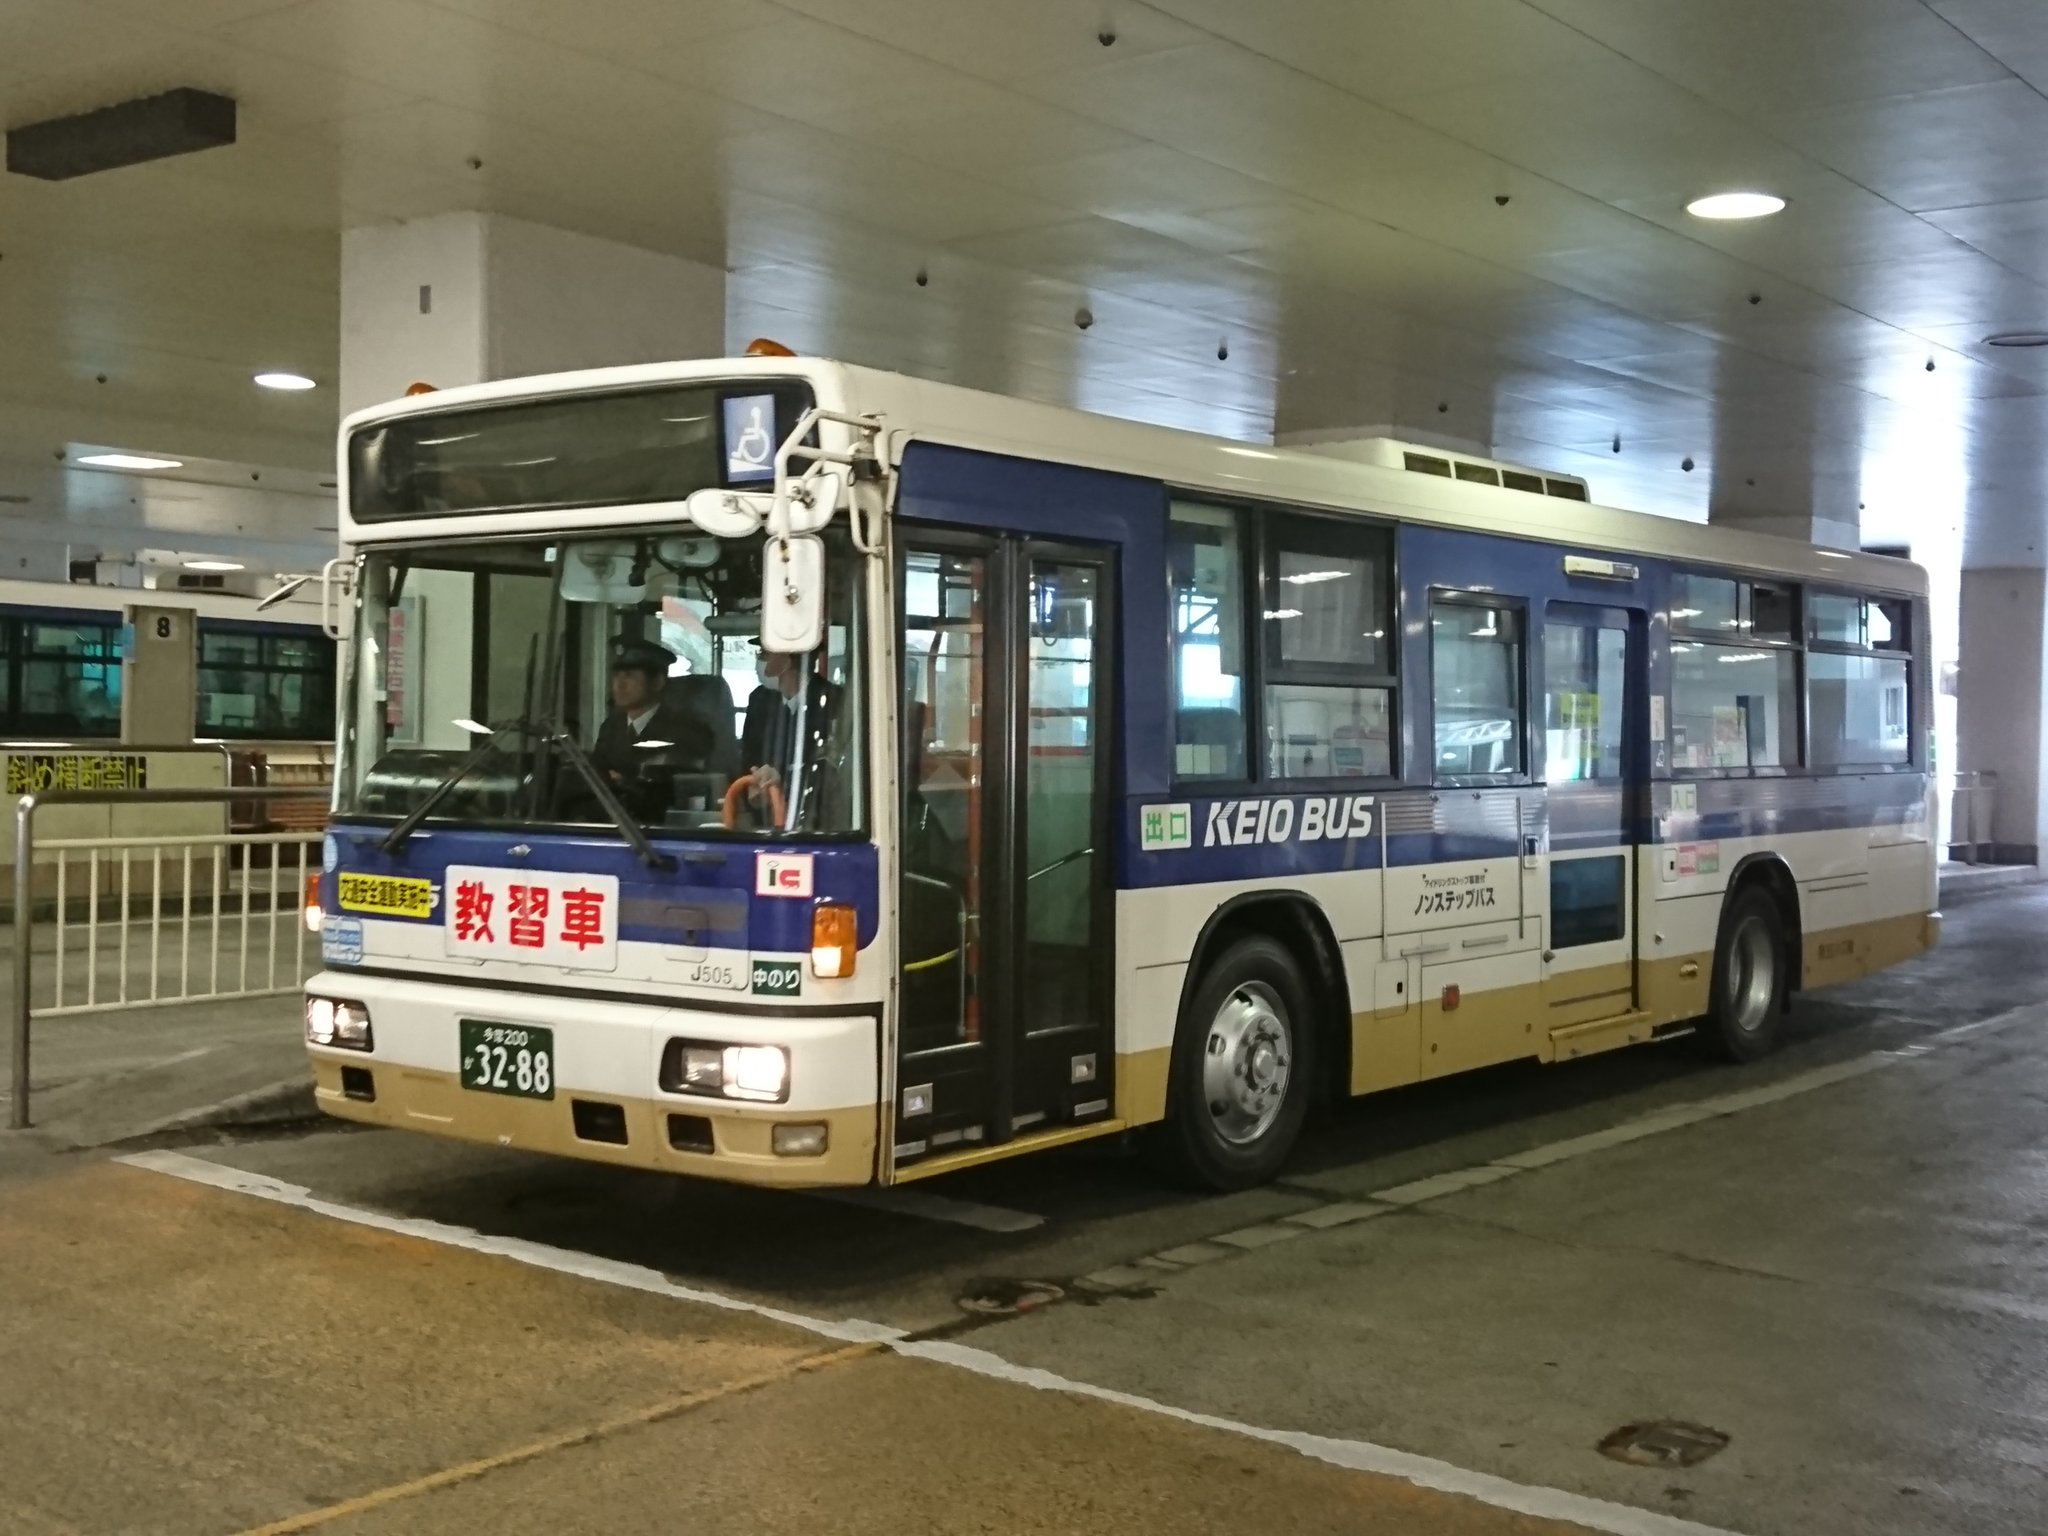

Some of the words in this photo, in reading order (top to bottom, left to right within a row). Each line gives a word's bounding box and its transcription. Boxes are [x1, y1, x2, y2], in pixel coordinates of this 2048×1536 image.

[157, 616, 170, 638] 8
[1146, 811, 1187, 842] 出口
[1204, 799, 1295, 848] KEIO
[1299, 796, 1375, 841] BUS
[455, 880, 605, 951] 教習車
[1414, 887, 1495, 916] ノンステップバス
[691, 965, 733, 985] J505
[752, 968, 800, 990] 中のり
[474, 1044, 551, 1094] 32-88
